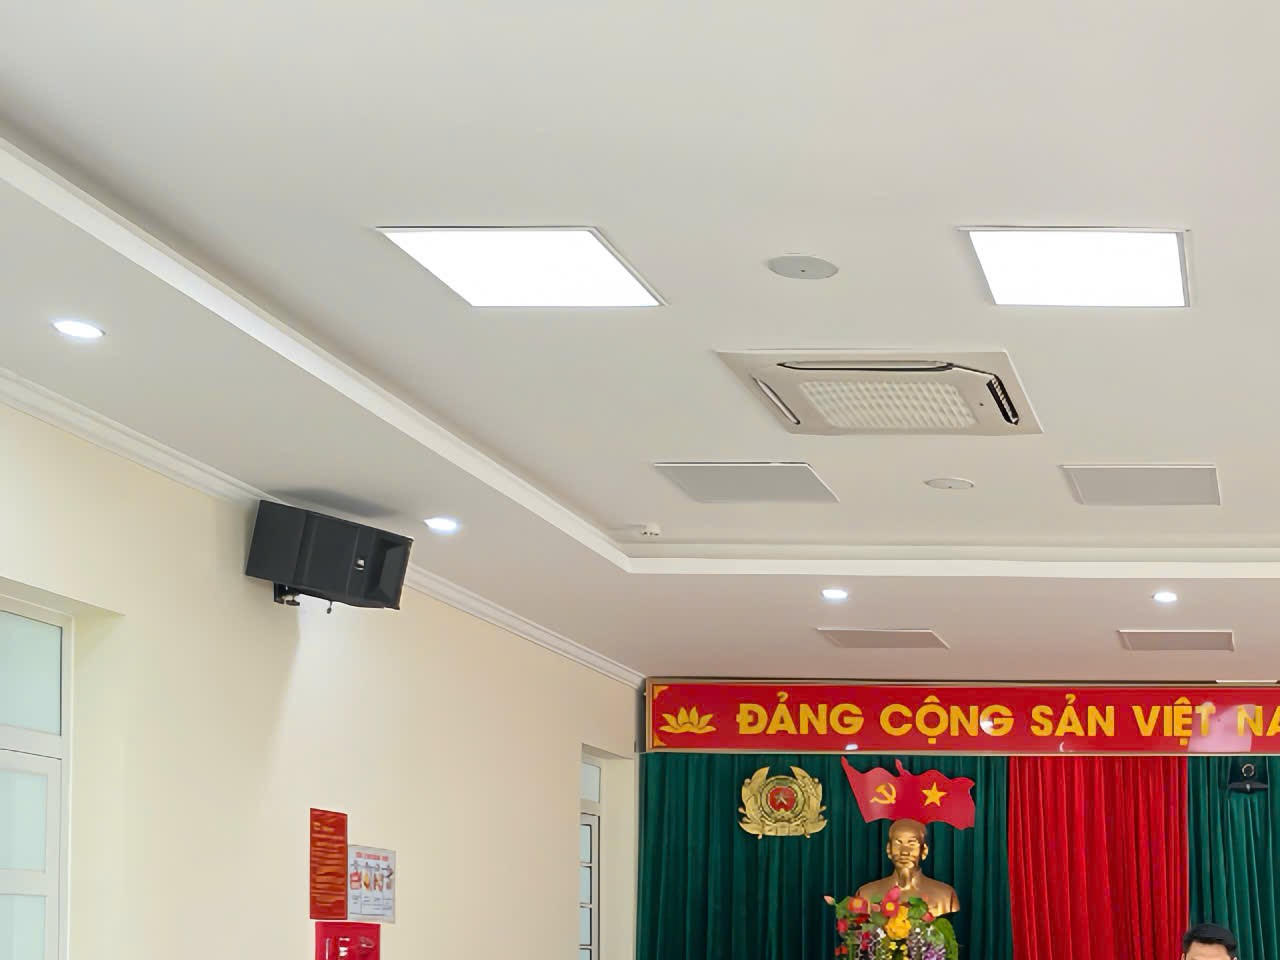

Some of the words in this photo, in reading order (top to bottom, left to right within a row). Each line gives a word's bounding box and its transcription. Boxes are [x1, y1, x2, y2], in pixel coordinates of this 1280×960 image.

[736, 691, 865, 735] ĐẢNG
[879, 695, 1015, 744] CỘNG
[1030, 693, 1116, 737] SẢN
[1131, 696, 1217, 746] VIỆT
